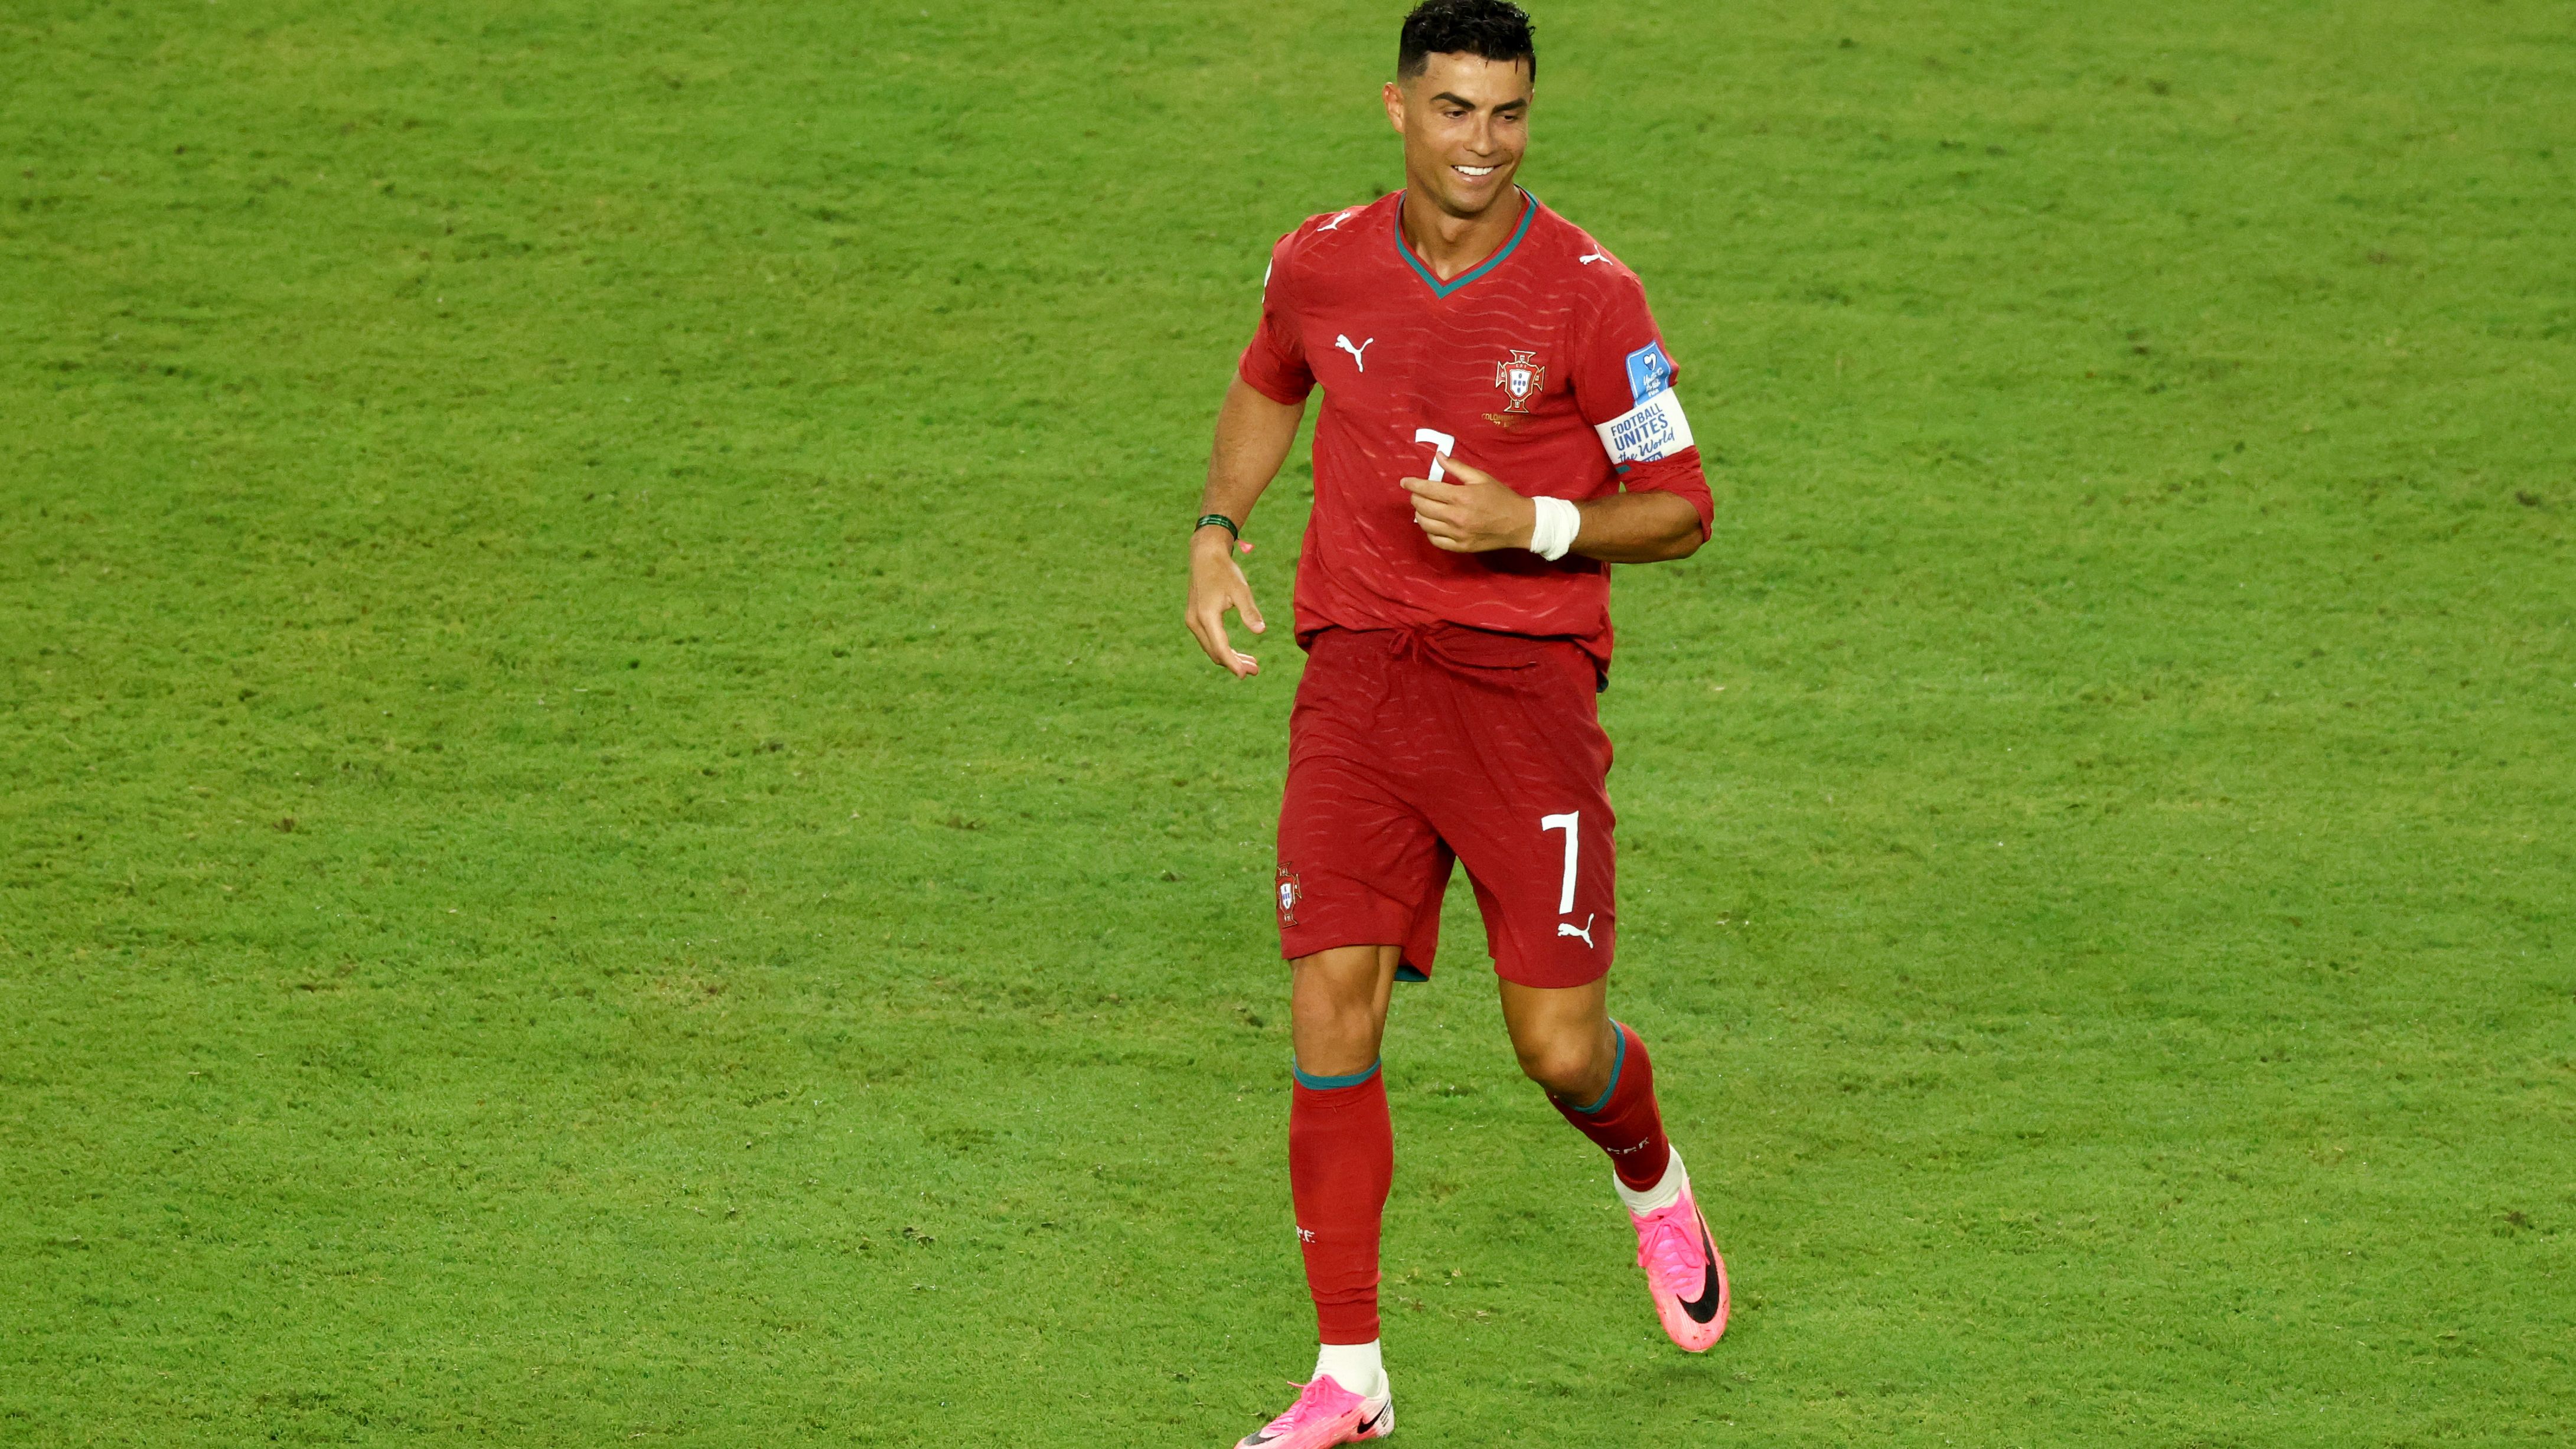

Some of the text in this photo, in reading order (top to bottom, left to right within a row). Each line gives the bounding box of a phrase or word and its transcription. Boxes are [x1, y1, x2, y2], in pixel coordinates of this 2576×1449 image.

[1610, 403, 1662, 436] FOOTBALL
[1614, 413, 1668, 451] UNITES
[1638, 426, 1675, 456] World
[1414, 428, 1455, 523] 7
[1541, 810, 1579, 915] 7
